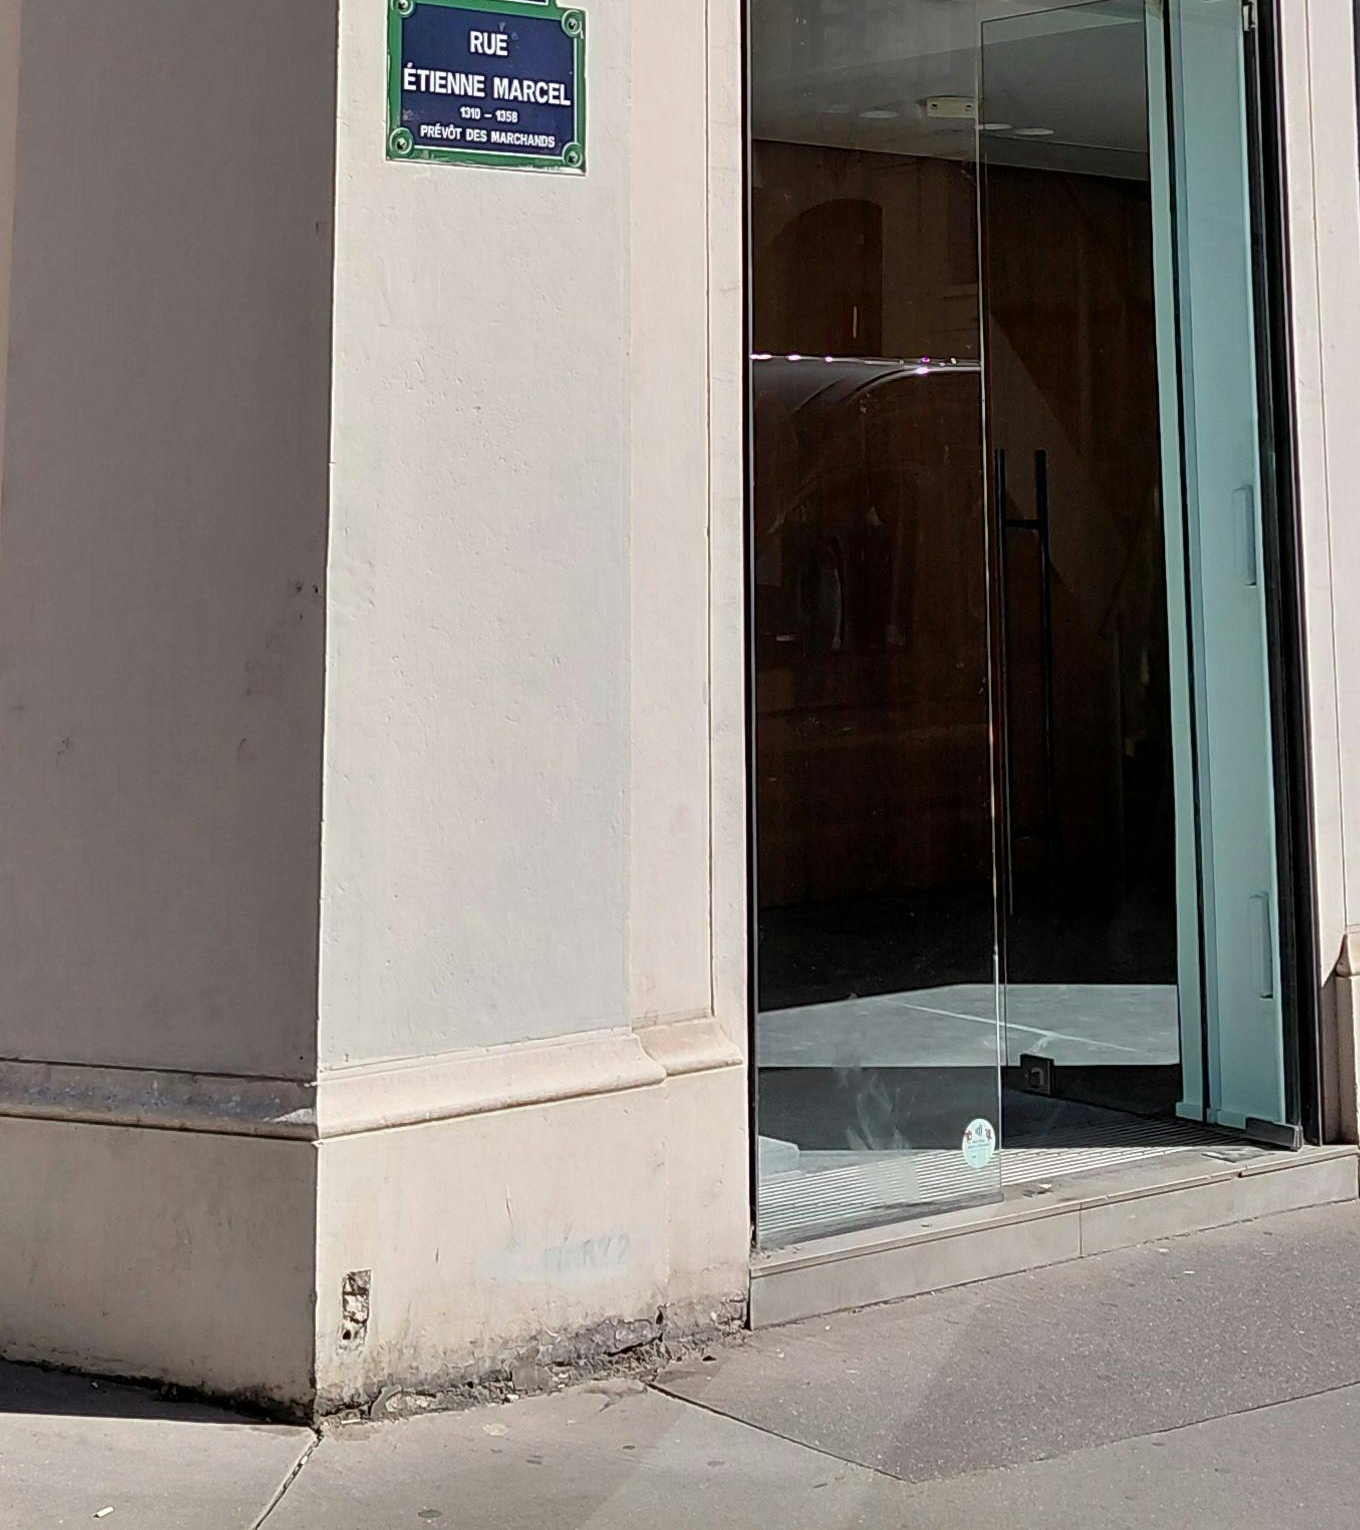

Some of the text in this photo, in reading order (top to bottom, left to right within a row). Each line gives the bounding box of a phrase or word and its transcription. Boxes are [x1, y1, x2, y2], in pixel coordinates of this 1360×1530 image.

[469, 30, 509, 56] RUE
[403, 62, 572, 106] ÉTIENNE MARCEL
[459, 106, 481, 120] 1310
[495, 109, 518, 123] 1358
[420, 123, 556, 148] PRÉVÔT DES MARCHANDS
